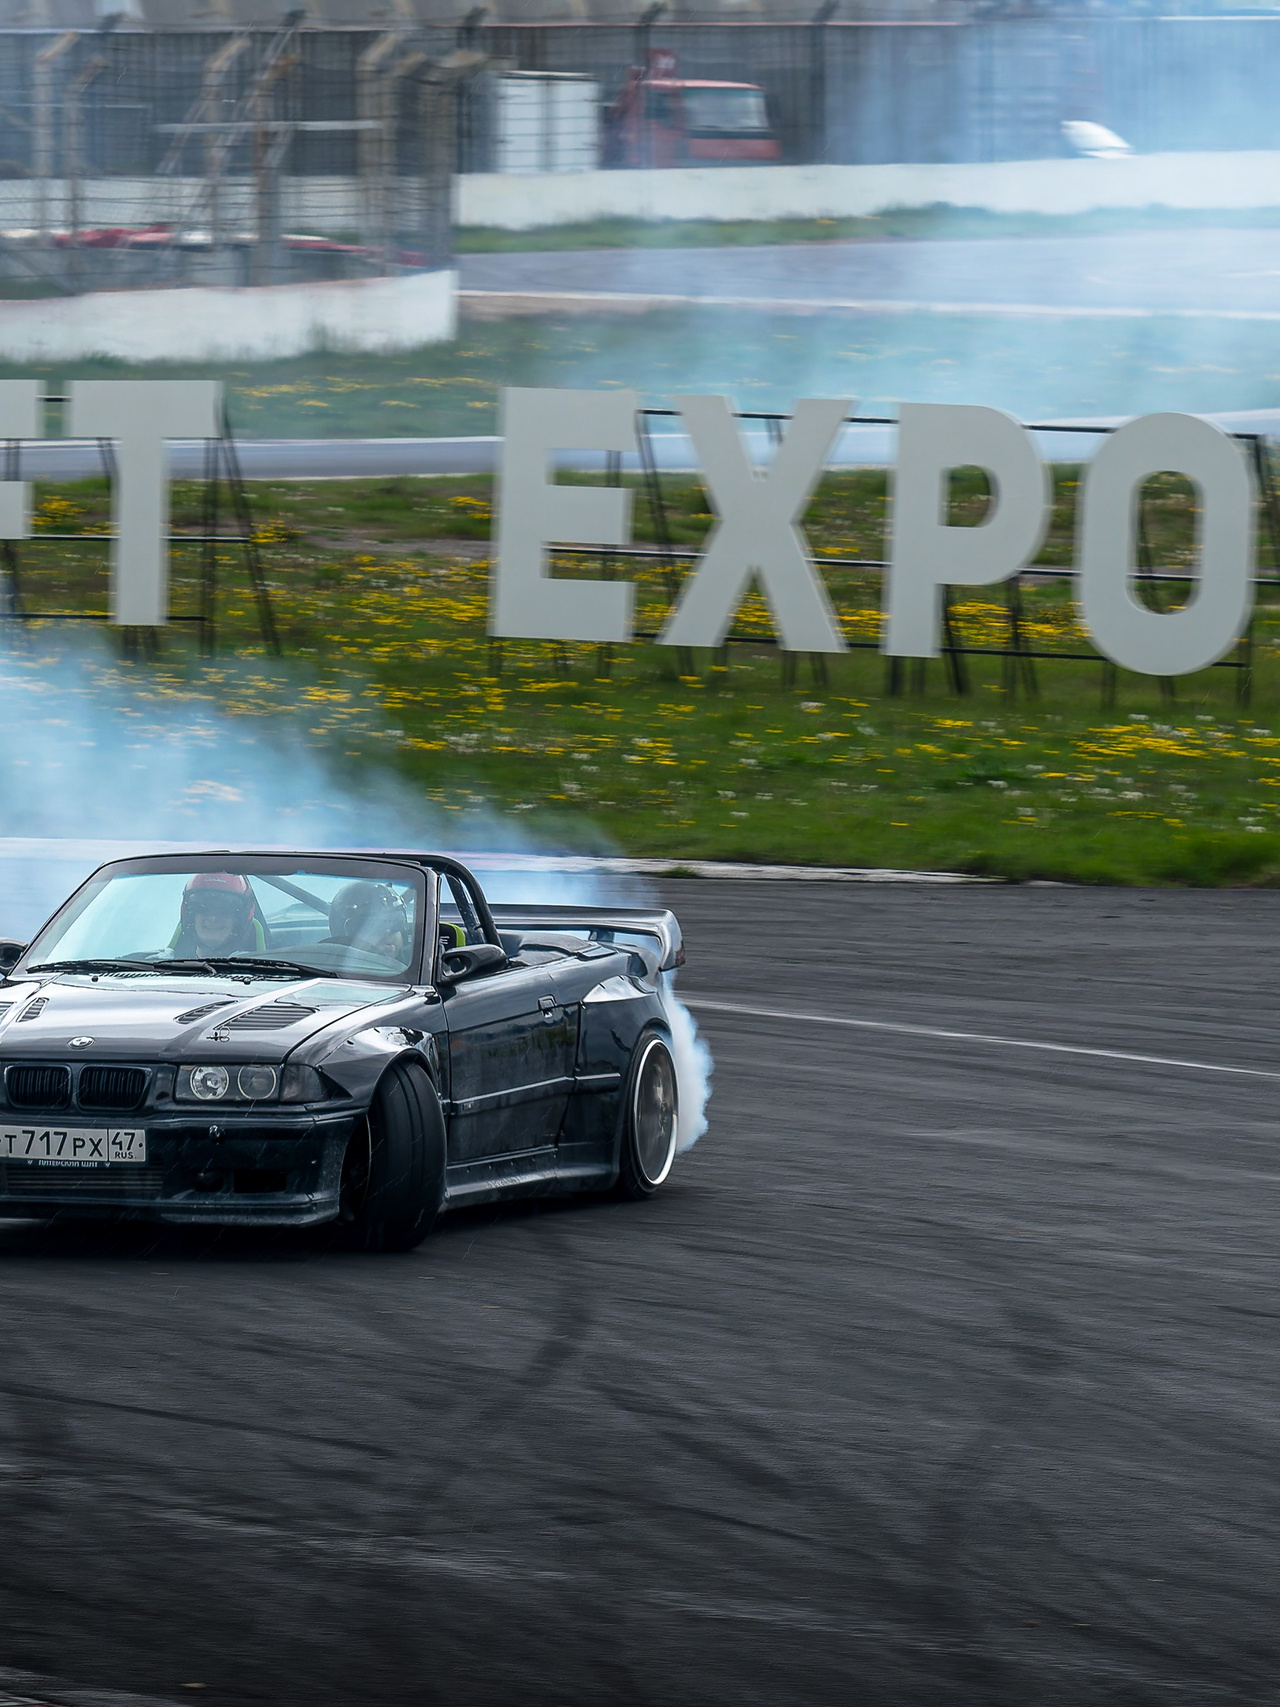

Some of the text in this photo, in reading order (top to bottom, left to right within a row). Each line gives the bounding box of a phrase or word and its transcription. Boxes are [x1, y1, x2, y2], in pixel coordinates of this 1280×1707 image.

[490, 387, 1258, 677] EXPO
[111, 1131, 136, 1151] 47
[114, 1151, 134, 1160] RUS
